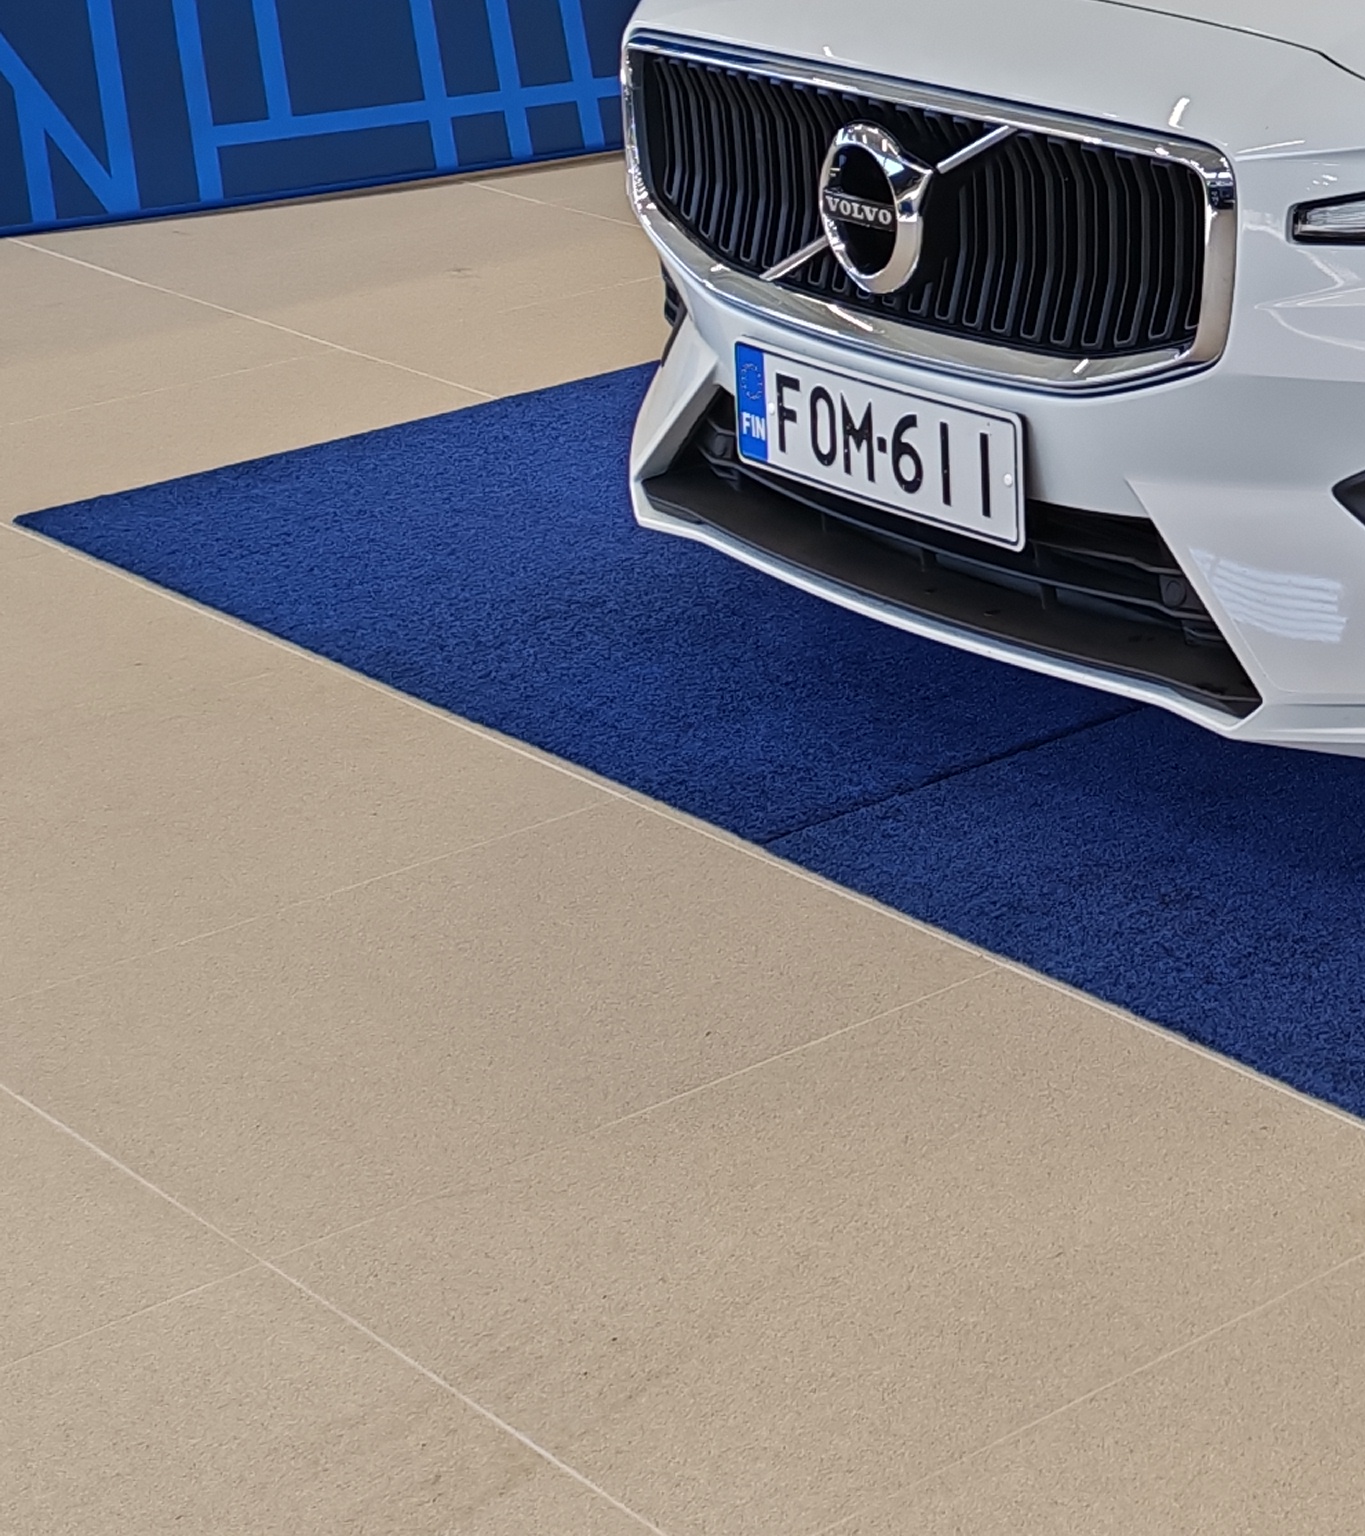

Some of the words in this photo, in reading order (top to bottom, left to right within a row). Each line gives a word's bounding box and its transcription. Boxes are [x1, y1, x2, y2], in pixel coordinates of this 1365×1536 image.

[825, 195, 892, 225] VOLVO
[741, 410, 767, 442] FIN
[775, 372, 992, 519] FOM-611
